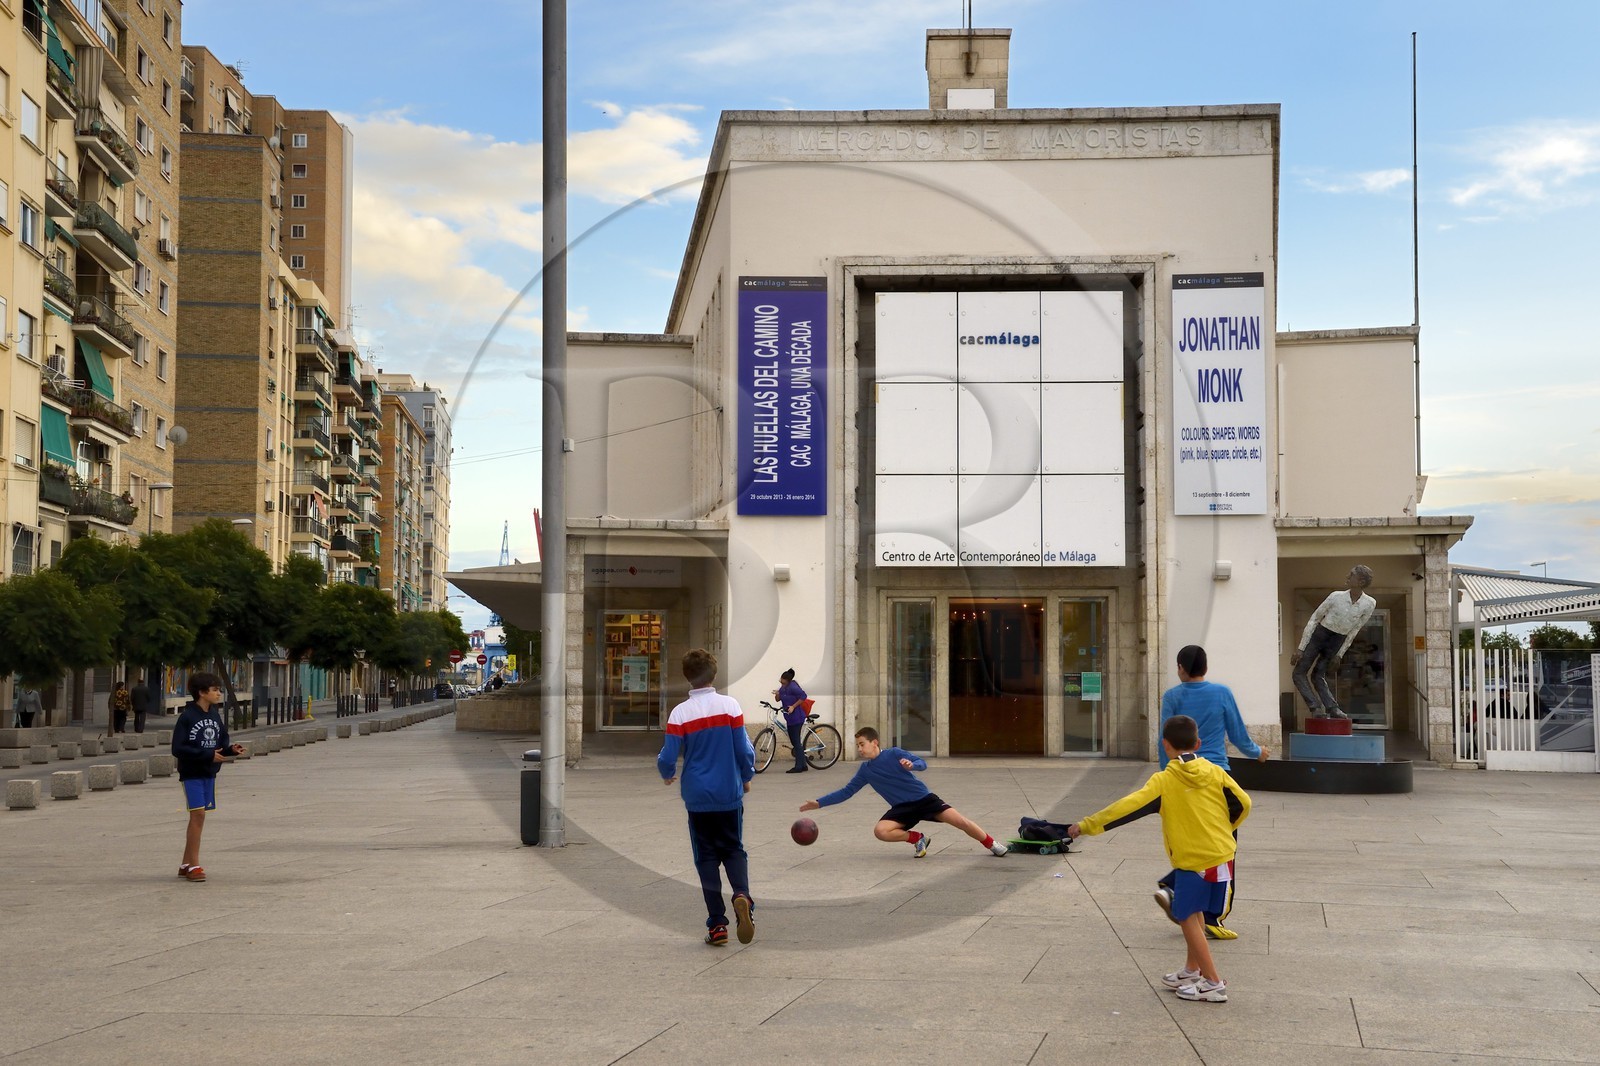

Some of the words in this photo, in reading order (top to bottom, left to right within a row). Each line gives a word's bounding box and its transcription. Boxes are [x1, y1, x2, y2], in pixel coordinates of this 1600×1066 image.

[797, 128, 933, 151] MERCADO
[964, 128, 999, 150] DE
[1031, 126, 1203, 150] MAYORISTAS
[754, 304, 779, 358] CAMINO
[786, 320, 811, 364] DÉCADA
[960, 332, 1040, 347] cacmálaga
[1179, 316, 1260, 352] JONATHAN
[754, 361, 778, 387] DEL
[791, 366, 811, 389] UNA
[1198, 368, 1243, 403] MONK
[754, 391, 778, 452] HUELLAS
[786, 392, 815, 439] MÁLAGA,
[1181, 427, 1211, 443] COLOURS,
[1212, 427, 1237, 443] SHAPES,
[1238, 426, 1260, 440] WORDS
[790, 444, 811, 467] CAC
[1197, 447, 1210, 462] blue,
[1211, 450, 1231, 462] square,
[1232, 447, 1249, 461] circle,
[754, 456, 778, 482] LAS
[882, 552, 916, 562] Centro
[918, 551, 931, 562] de
[934, 551, 955, 562] Arte
[960, 551, 1040, 565] Contemporáneo
[1044, 551, 1056, 562] de
[1059, 551, 1096, 565] Málaga
